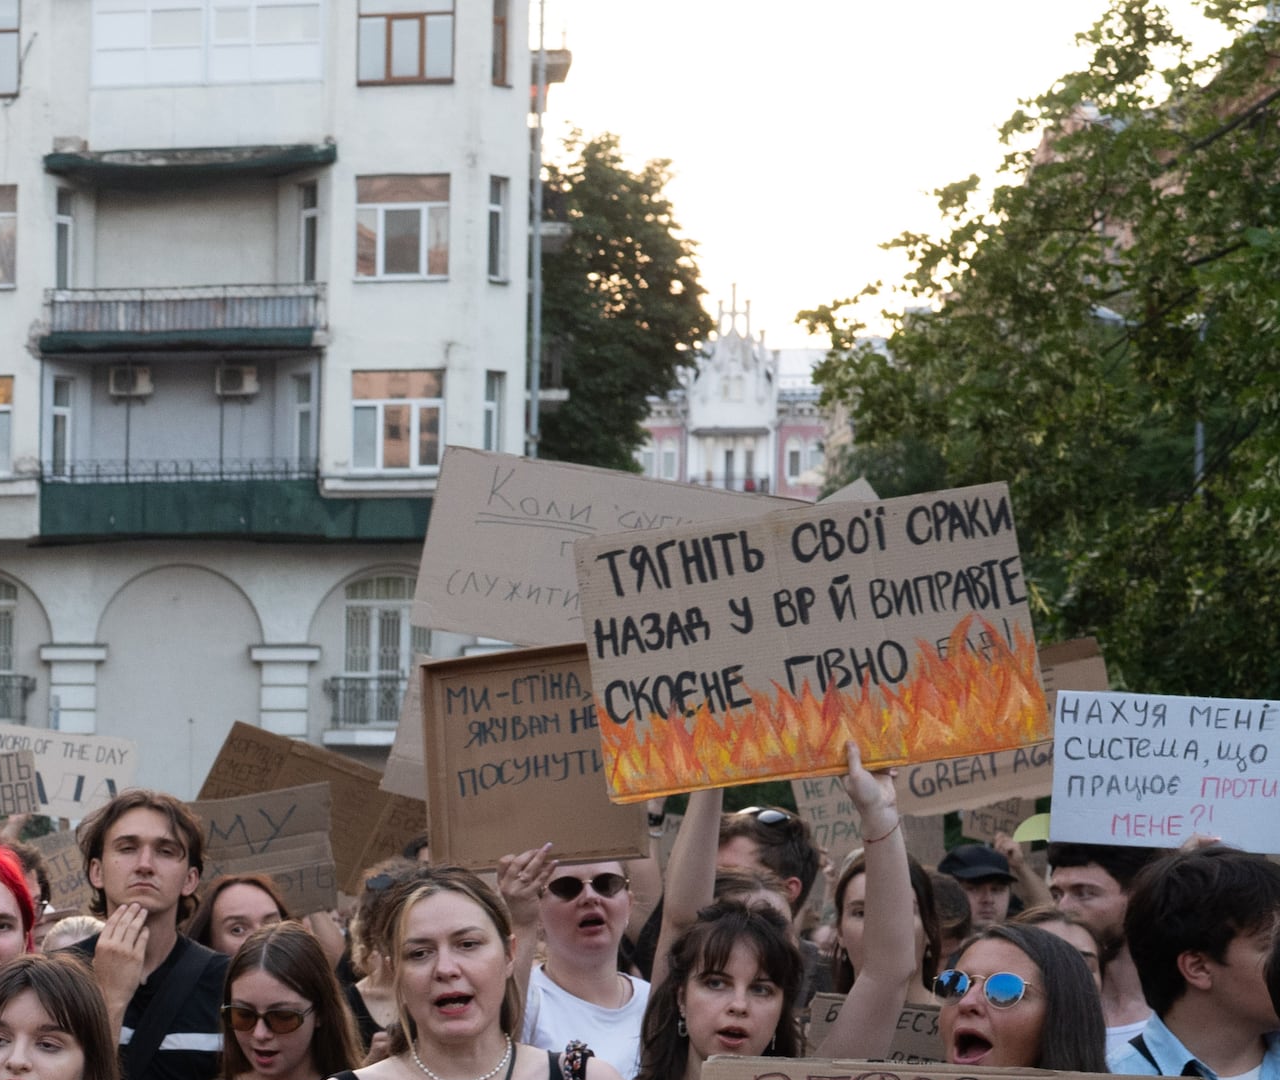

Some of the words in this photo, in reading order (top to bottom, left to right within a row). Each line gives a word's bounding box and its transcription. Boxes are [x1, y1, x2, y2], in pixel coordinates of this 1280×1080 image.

[596, 531, 764, 596] ТЯГНІТЬ
[792, 508, 886, 563] СВОЇ
[906, 497, 1013, 544] СРАКИ
[594, 607, 710, 658] НАЗАД
[728, 596, 753, 634] У
[774, 587, 814, 627] ВР
[829, 574, 857, 622] Й
[870, 556, 1028, 619] ВИПРАВТЕ
[784, 640, 908, 696] ГІВНО
[1060, 697, 1167, 728] НАХУЯ
[33, 739, 52, 754] OF
[62, 741, 90, 760] THE
[95, 744, 129, 765] DAY
[909, 753, 999, 798] GREAT
[1067, 775, 1181, 801] ПРАЦЮЄ
[1201, 777, 1279, 799] ПРОТИ
